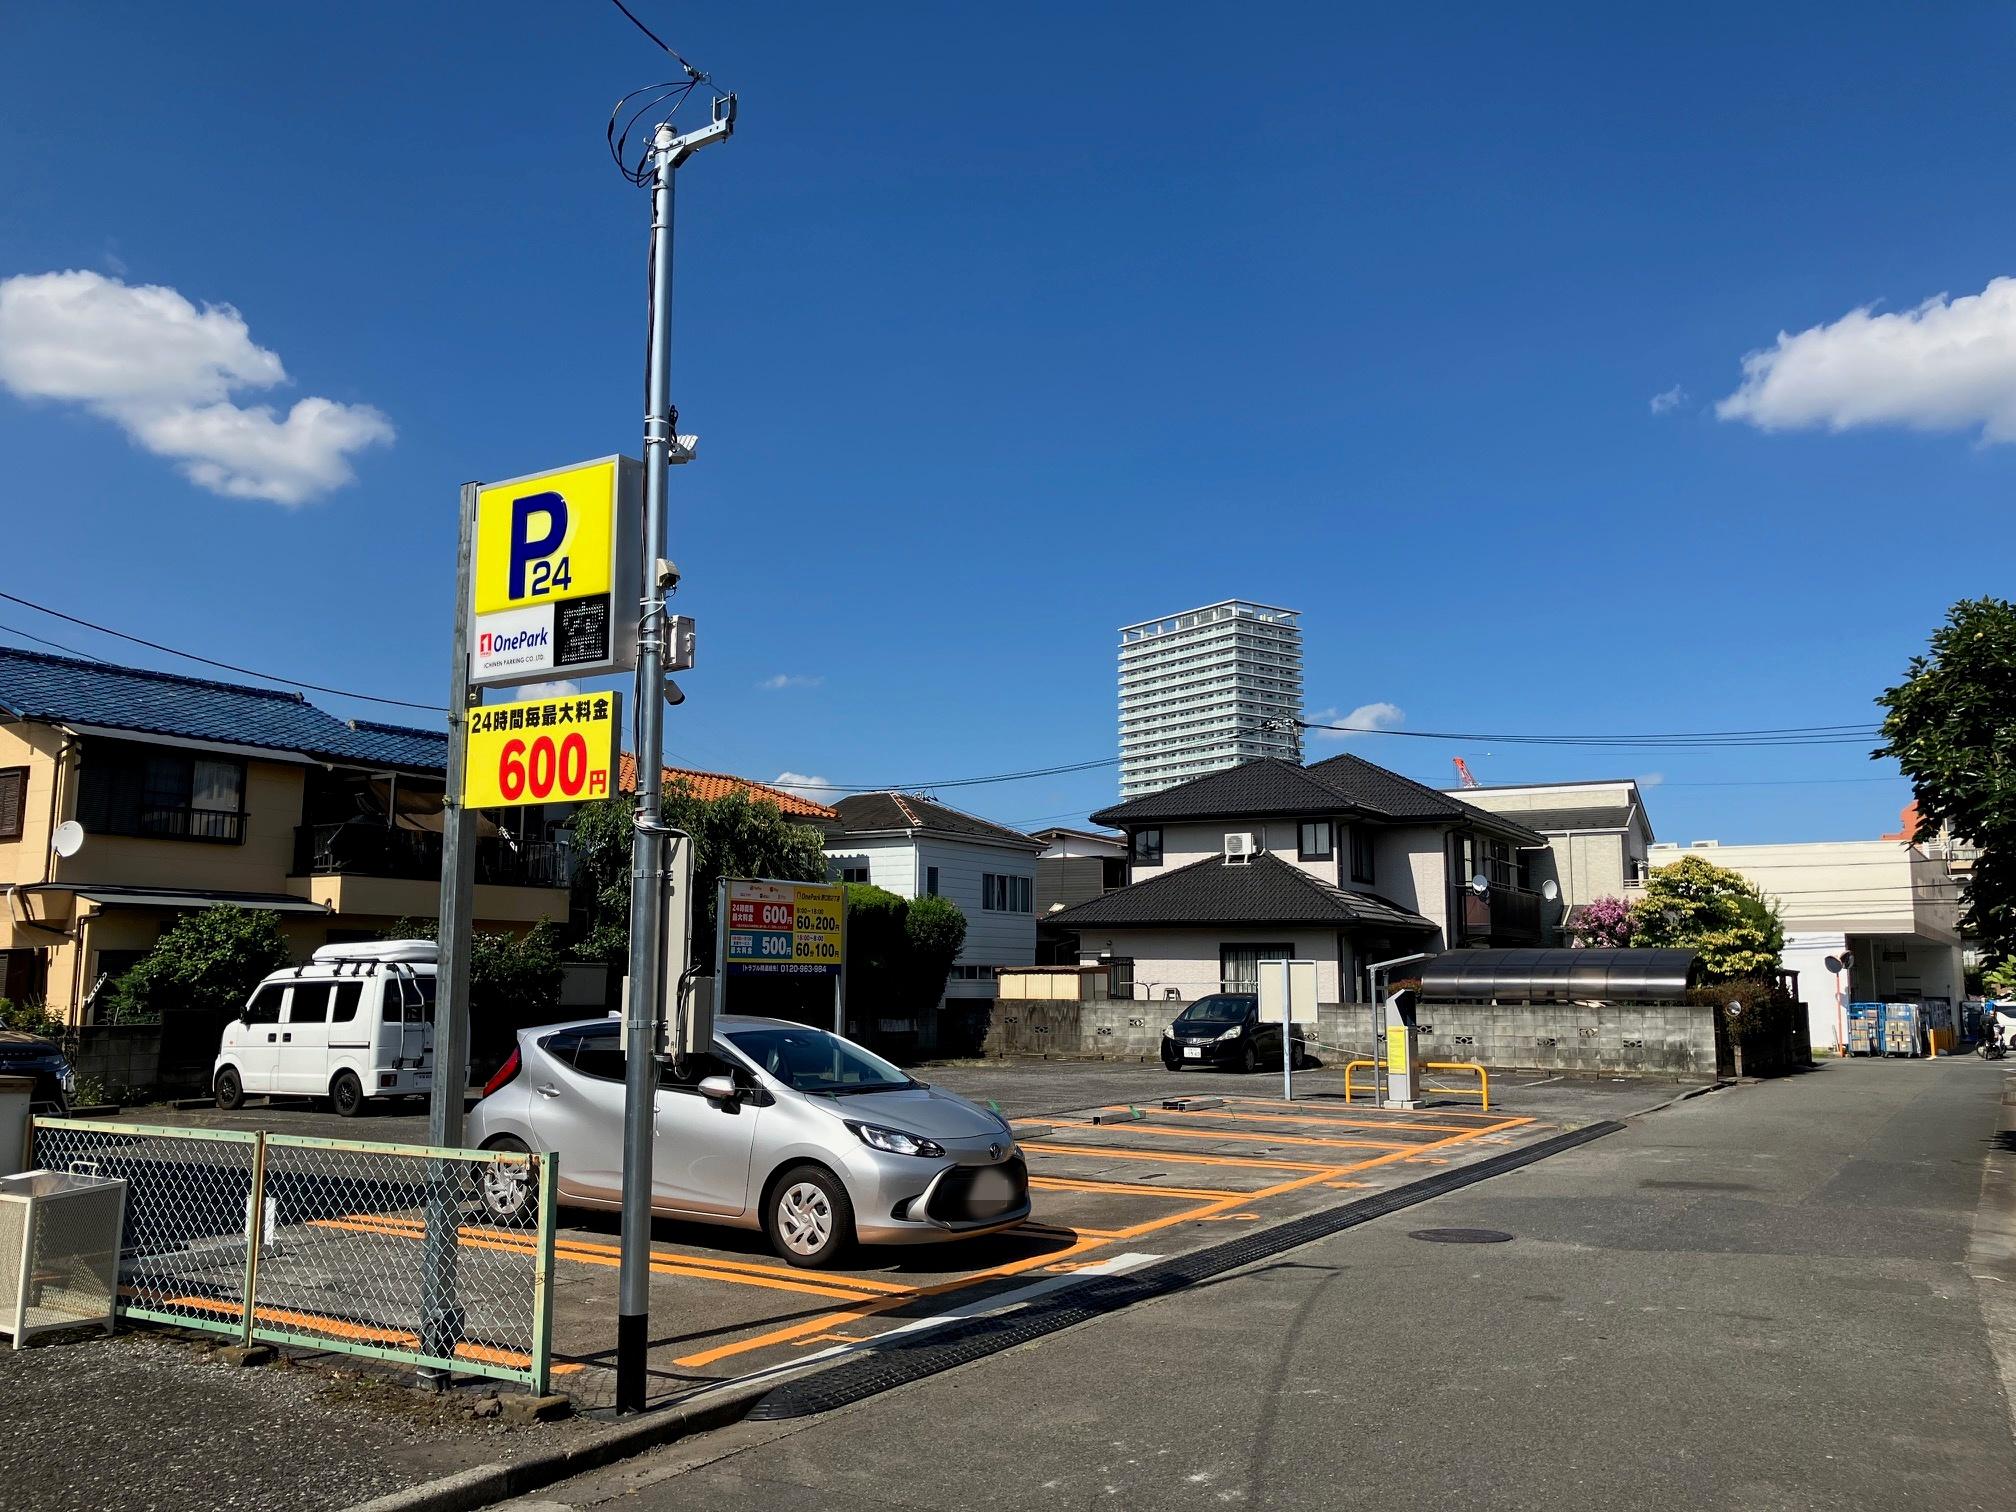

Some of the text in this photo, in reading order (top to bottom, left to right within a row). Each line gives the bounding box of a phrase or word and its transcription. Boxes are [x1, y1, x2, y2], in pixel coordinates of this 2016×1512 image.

[508, 490, 572, 601] P 24
[493, 626, 549, 653] OnePark
[503, 656, 525, 666] PARKING
[471, 697, 610, 735] 24時間毎最大料金
[498, 732, 608, 802] 600円
[762, 905, 793, 925] 600円
[761, 936, 792, 956] 500円
